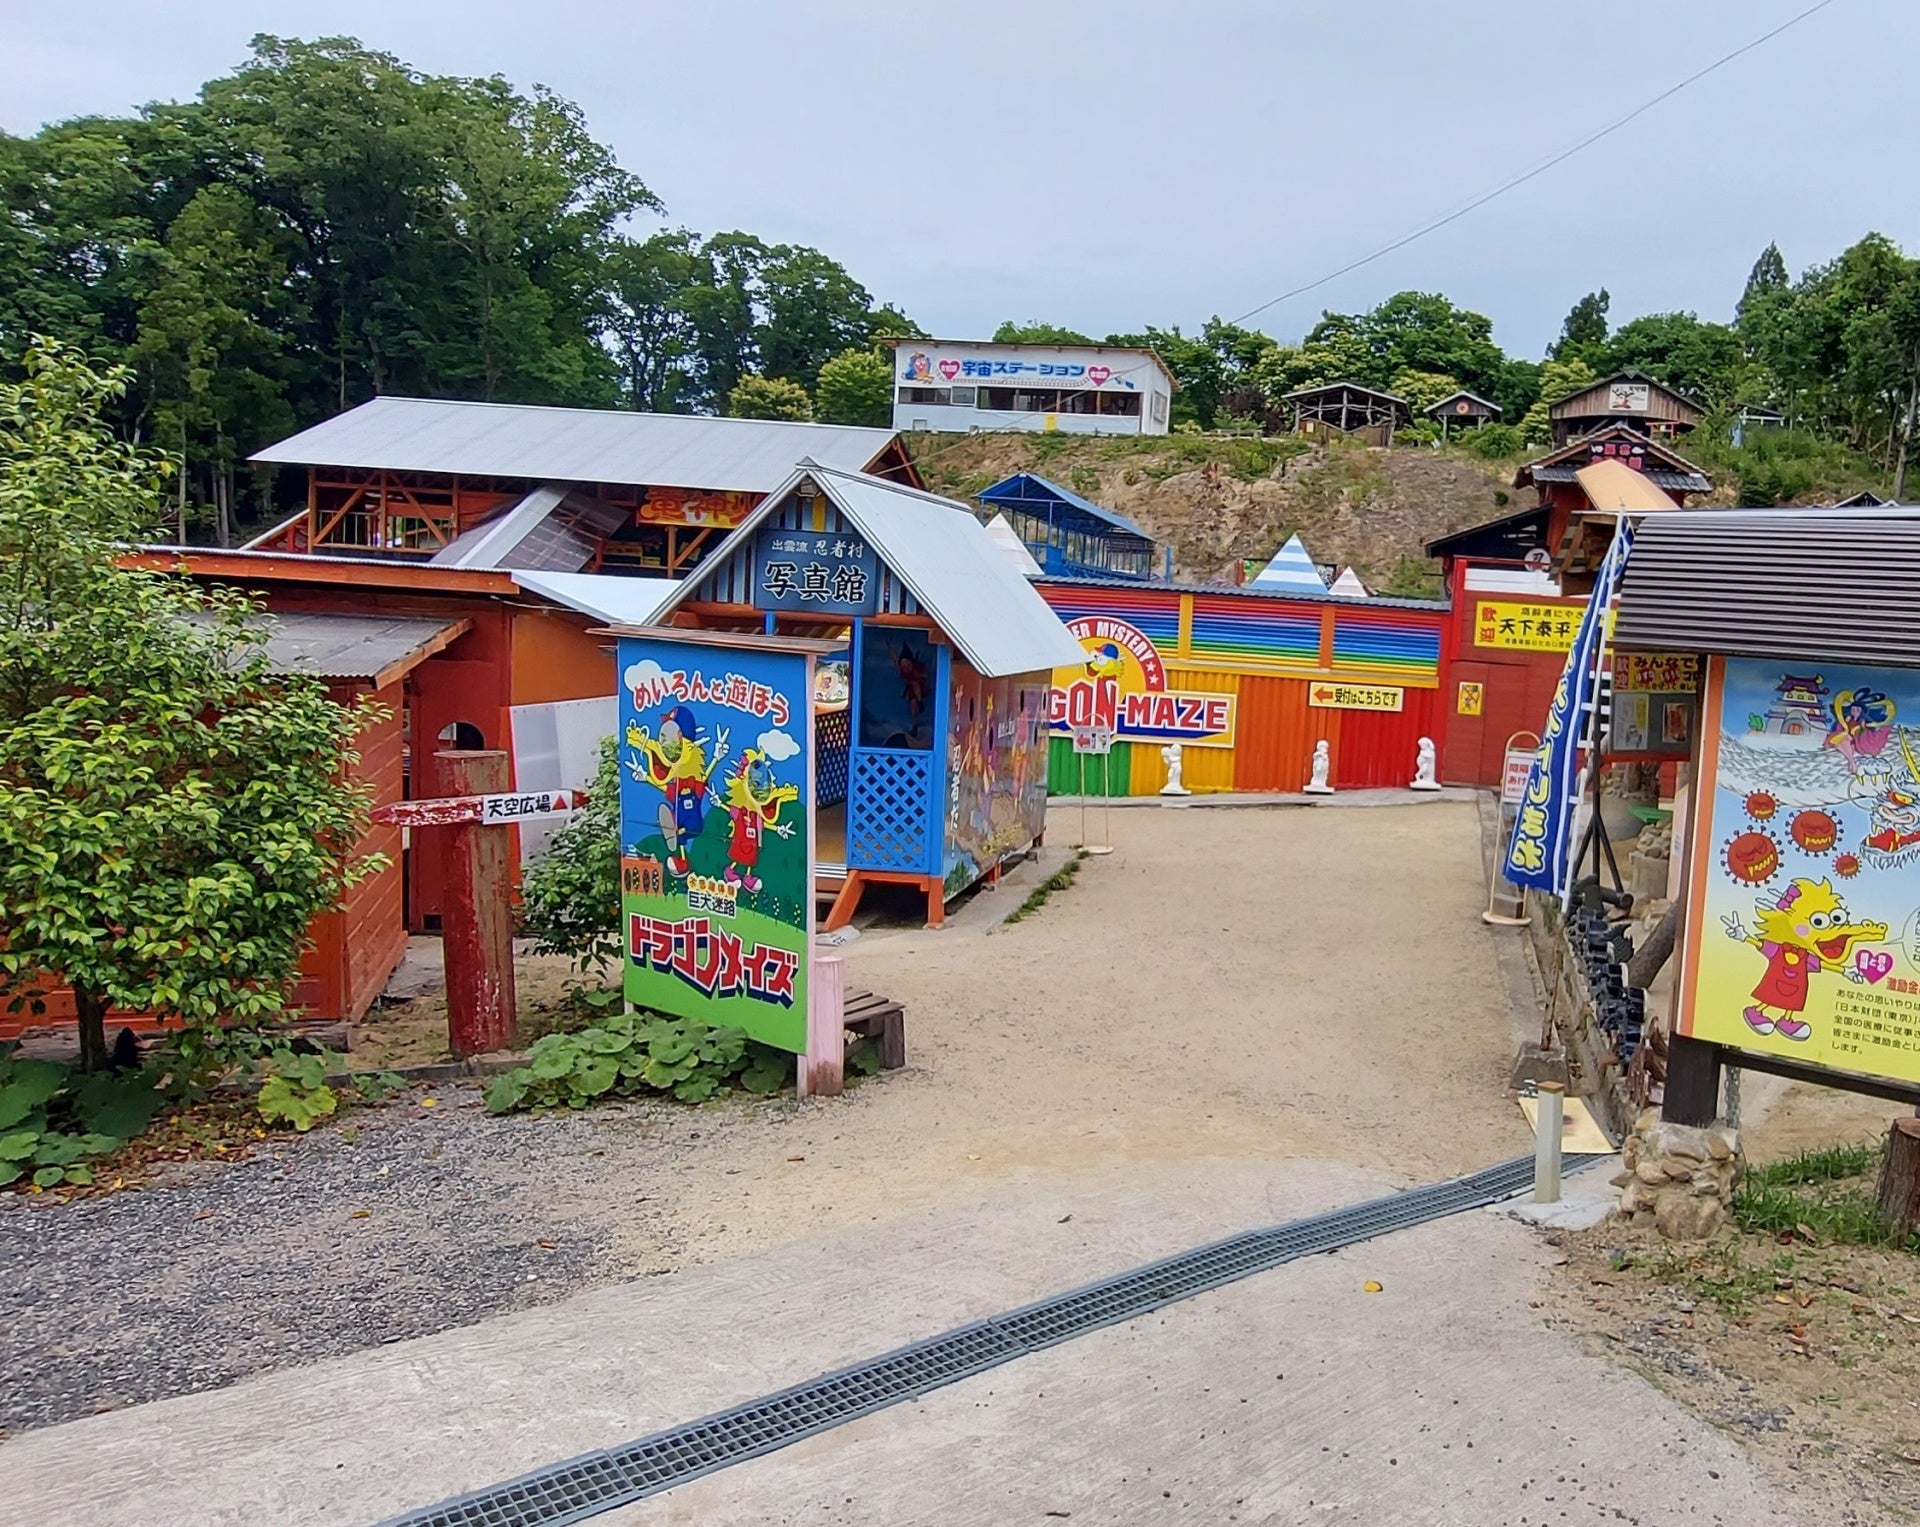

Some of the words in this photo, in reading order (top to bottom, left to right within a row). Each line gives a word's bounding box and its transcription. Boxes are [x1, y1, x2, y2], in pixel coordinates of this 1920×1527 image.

[962, 360, 1085, 378] 宇宙ステーション
[813, 540, 864, 558] 忍者村
[762, 561, 869, 604] 写真館
[1096, 621, 1154, 663] MYSTERY
[632, 671, 790, 726] めいろんと遊ぼう
[1335, 688, 1398, 707] 受付はこちらです
[487, 794, 551, 817] 天空広場
[688, 890, 736, 917] 巨大迷路
[629, 913, 800, 1003] ドラゴンメイズ
[1886, 977, 1920, 995] 激励金
[1835, 1002, 1920, 1025] 「日本財団(東京)」
[1831, 1041, 1863, 1055] します。
